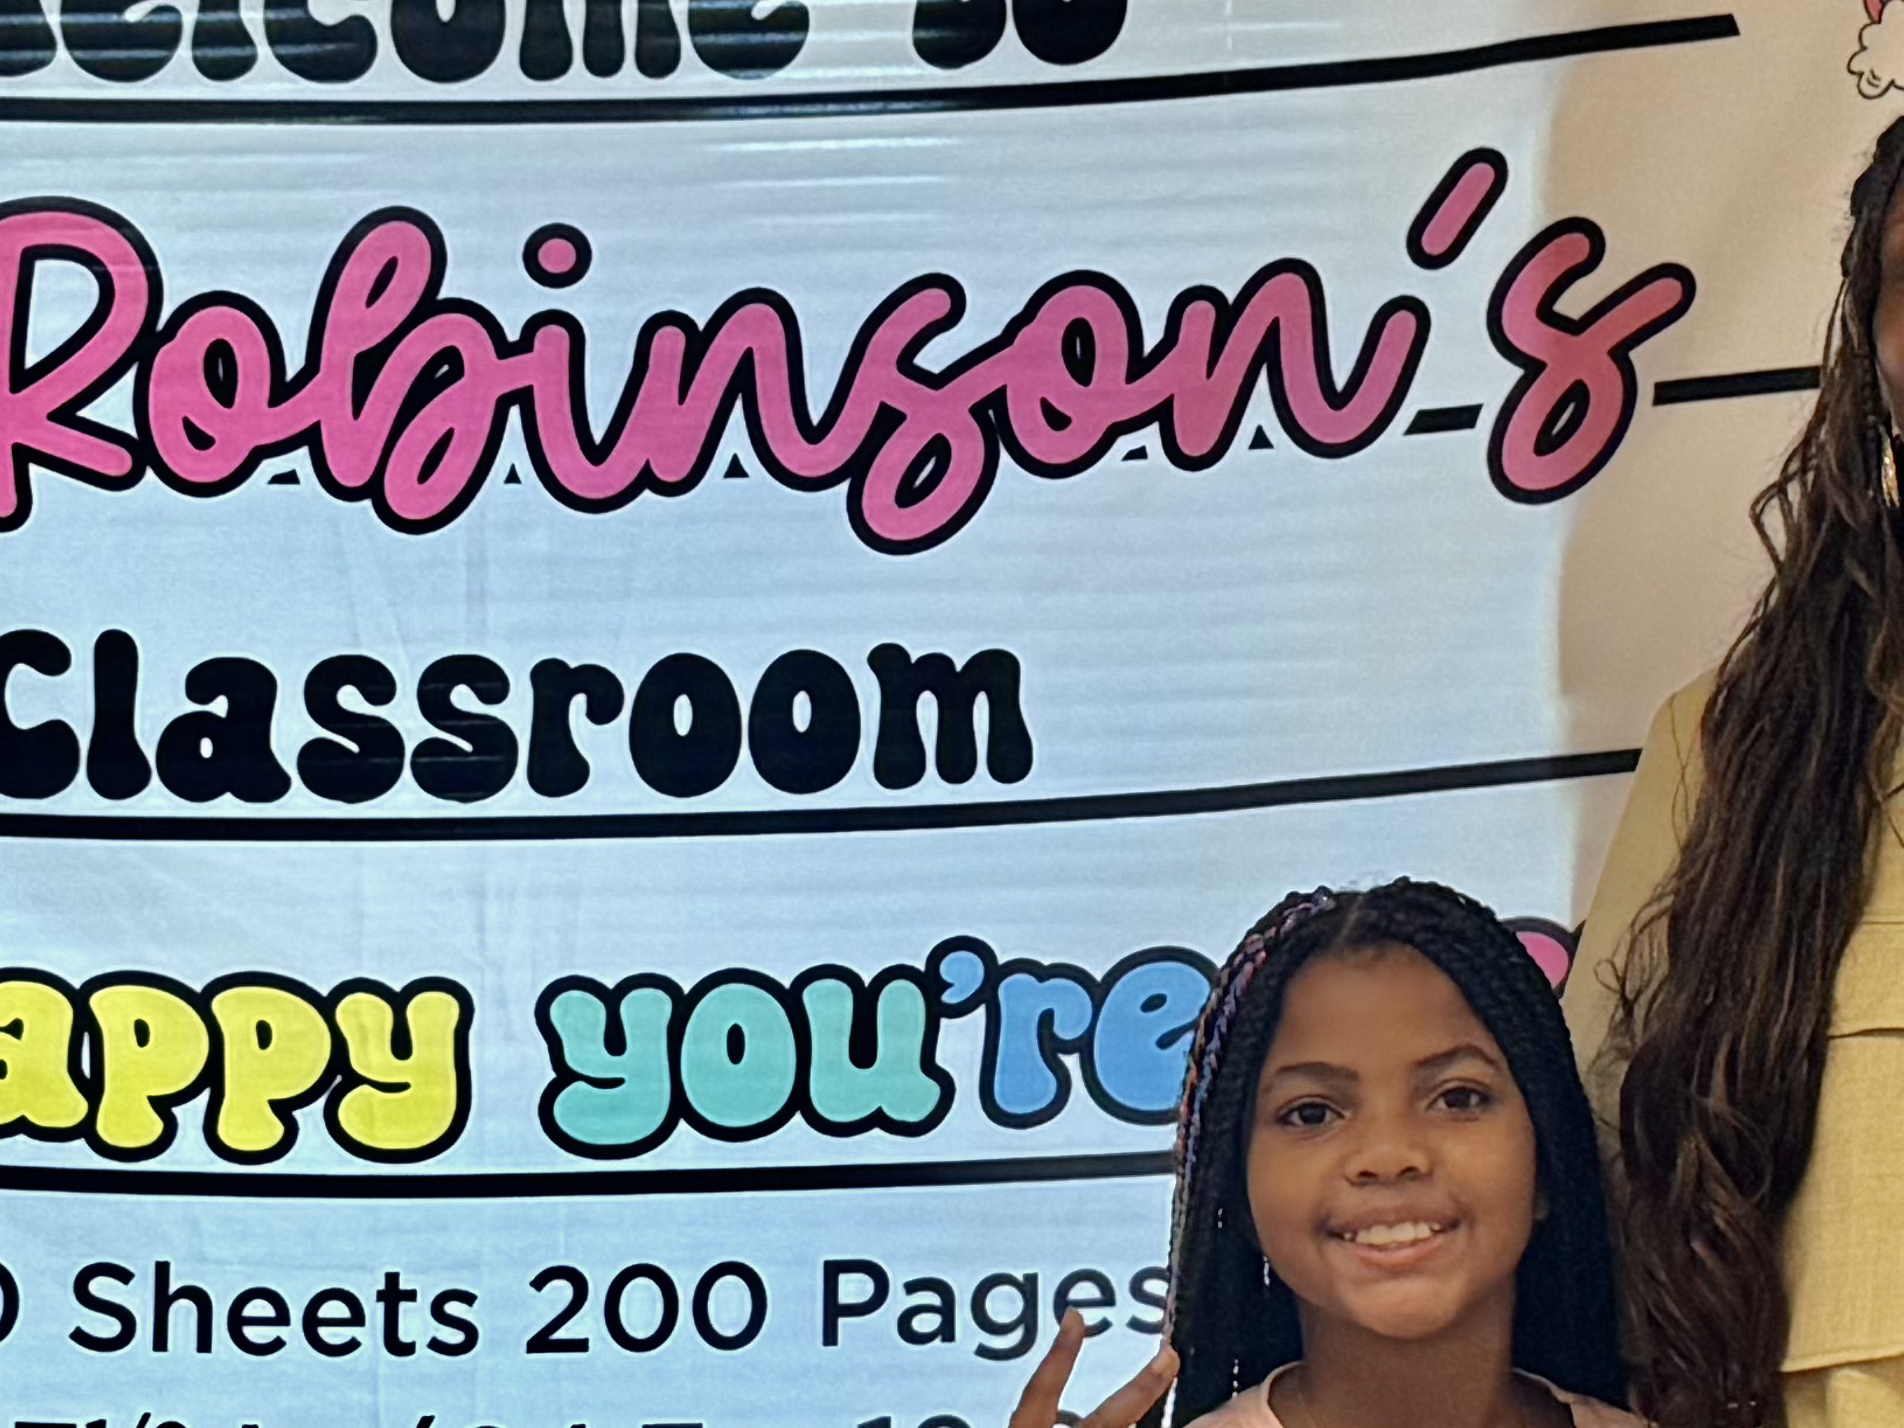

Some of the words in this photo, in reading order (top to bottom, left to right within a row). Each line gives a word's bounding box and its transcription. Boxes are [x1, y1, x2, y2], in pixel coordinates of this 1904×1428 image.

[536, 935, 1214, 1160] you're
[68, 1260, 479, 1357] Sheets
[526, 1260, 768, 1354] 200
[822, 1258, 1171, 1361] Pages
